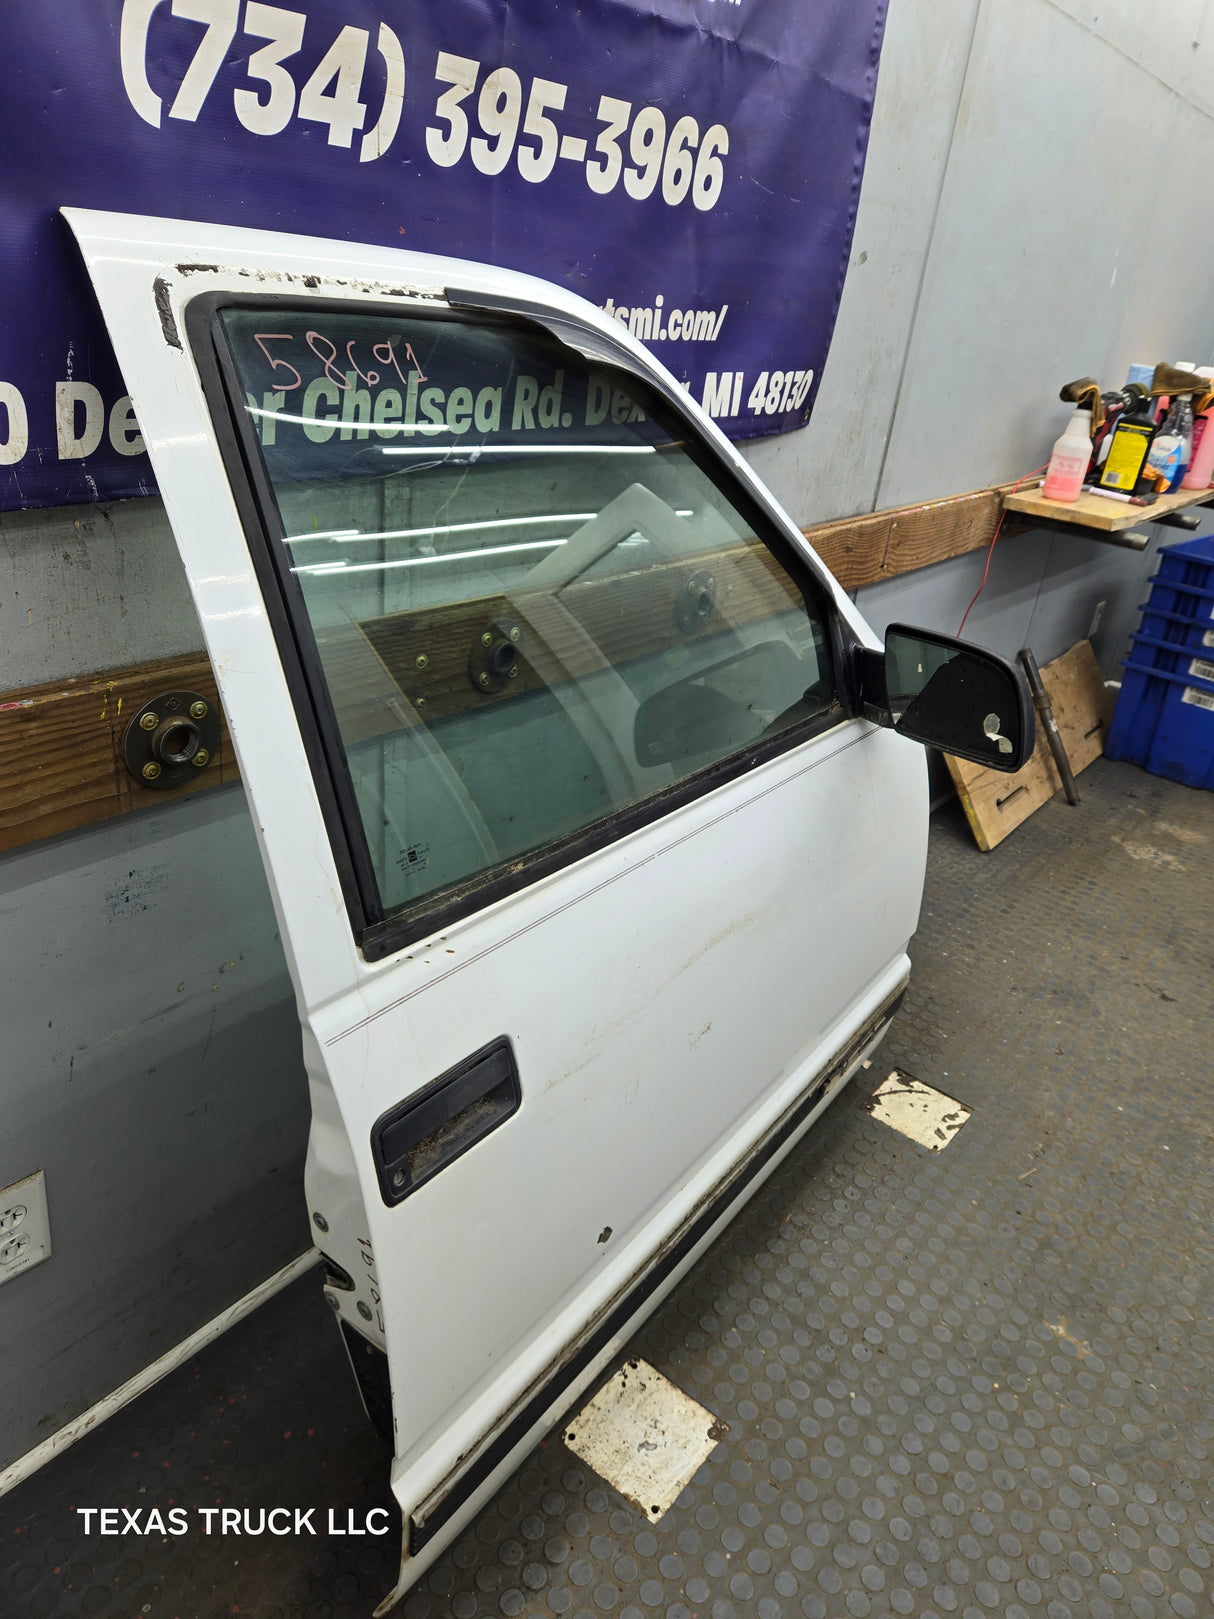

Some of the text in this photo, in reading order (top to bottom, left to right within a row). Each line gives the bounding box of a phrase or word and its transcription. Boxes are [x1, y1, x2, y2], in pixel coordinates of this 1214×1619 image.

[120, 0, 729, 211] (734) 395-3966
[254, 331, 428, 390] 58691
[302, 371, 502, 443] Chelsea
[511, 369, 573, 430] Rd.
[701, 372, 744, 417] MI
[748, 369, 814, 415] 48130
